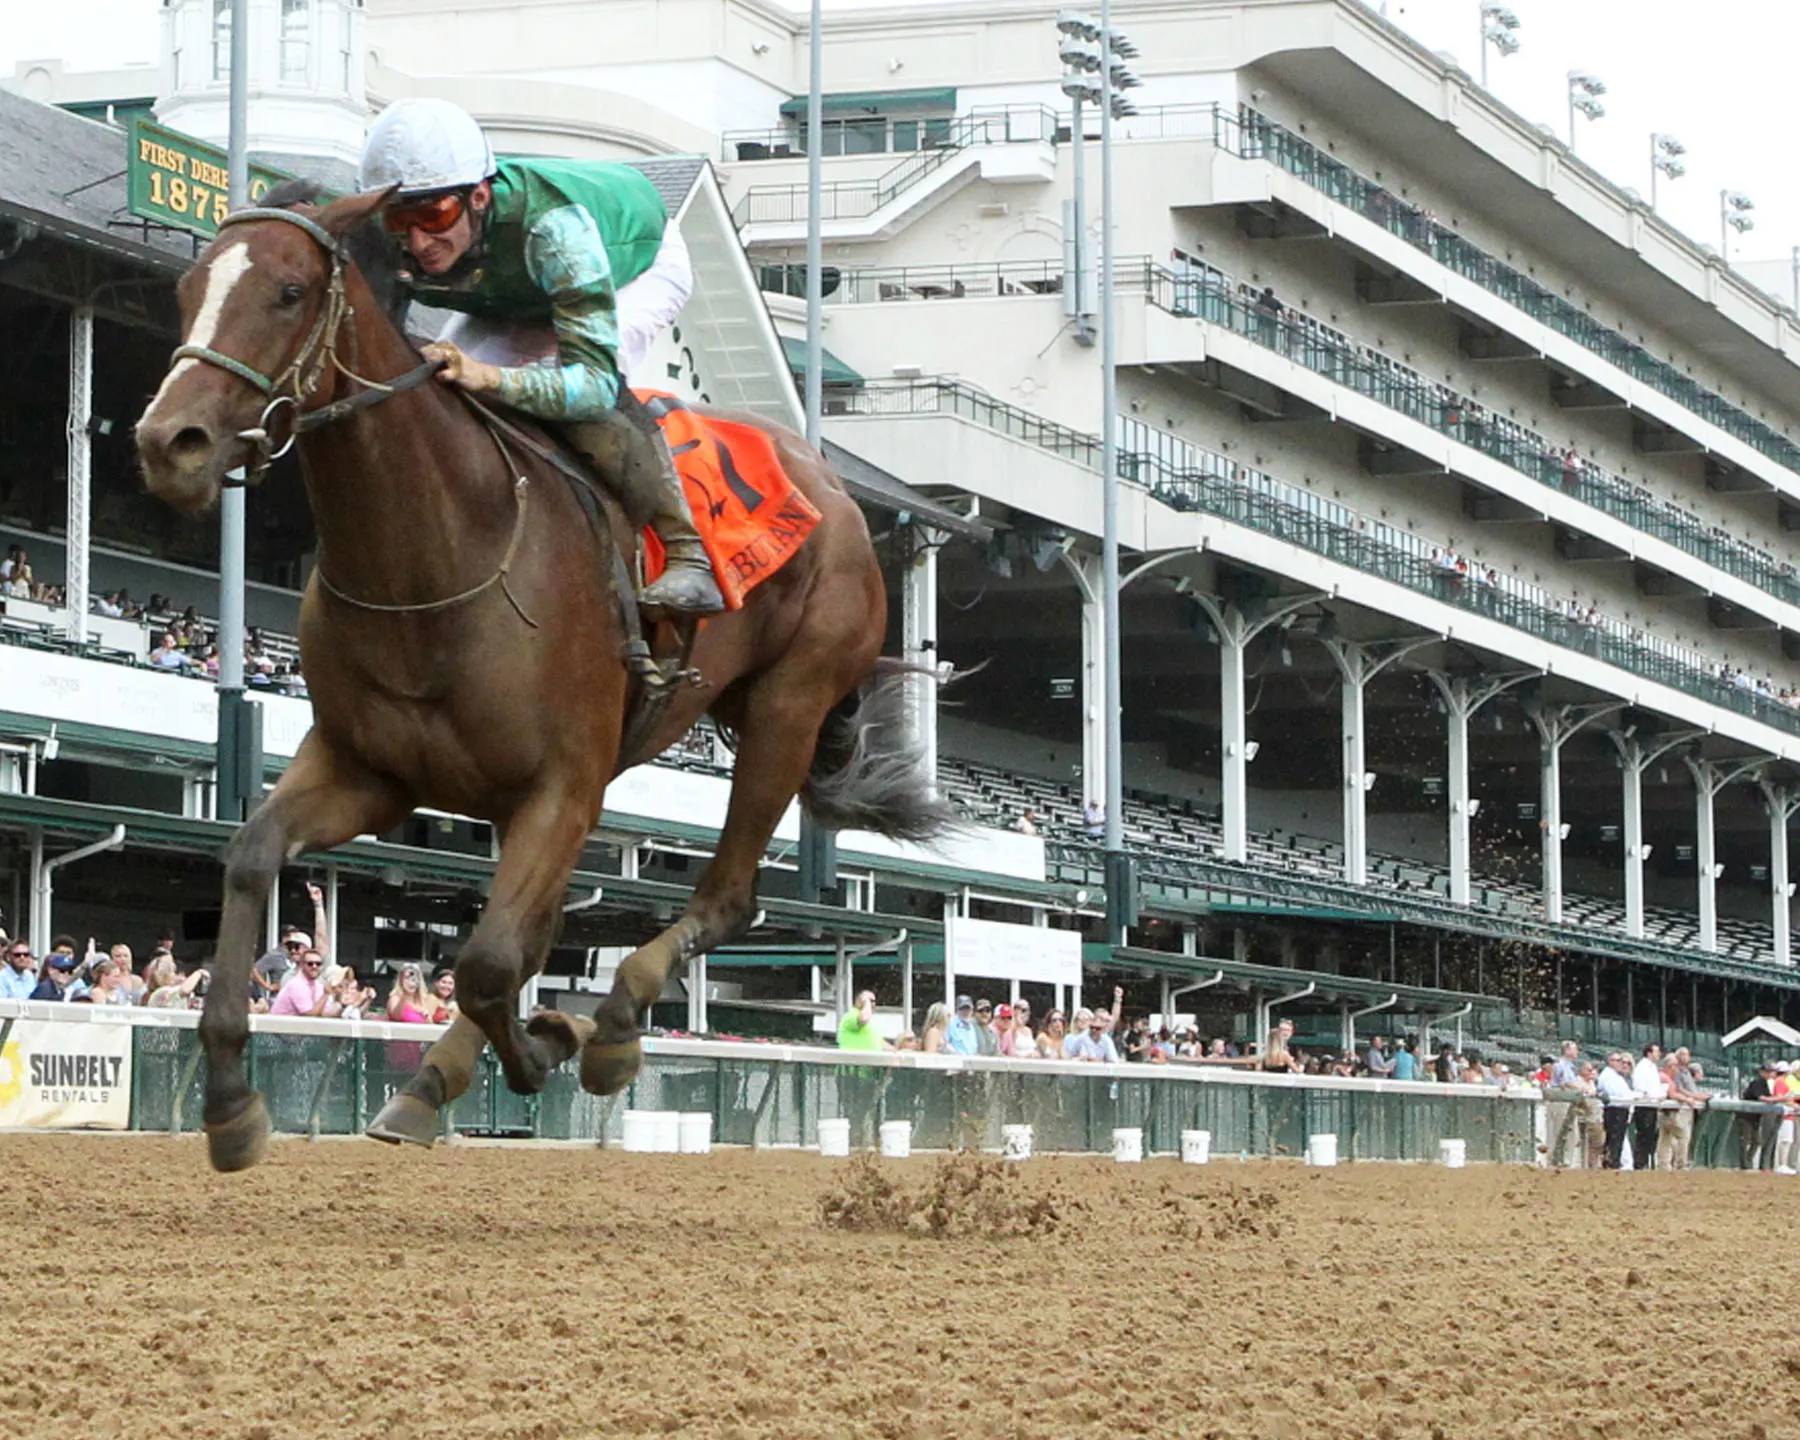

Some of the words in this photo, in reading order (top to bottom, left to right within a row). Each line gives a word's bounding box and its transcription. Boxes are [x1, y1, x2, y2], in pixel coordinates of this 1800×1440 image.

[139, 138, 187, 175] FIRST
[190, 157, 229, 191] DERB
[150, 171, 229, 226] 1875
[30, 1053, 122, 1088] SUNBELT
[41, 1089, 109, 1103] RENTALS
